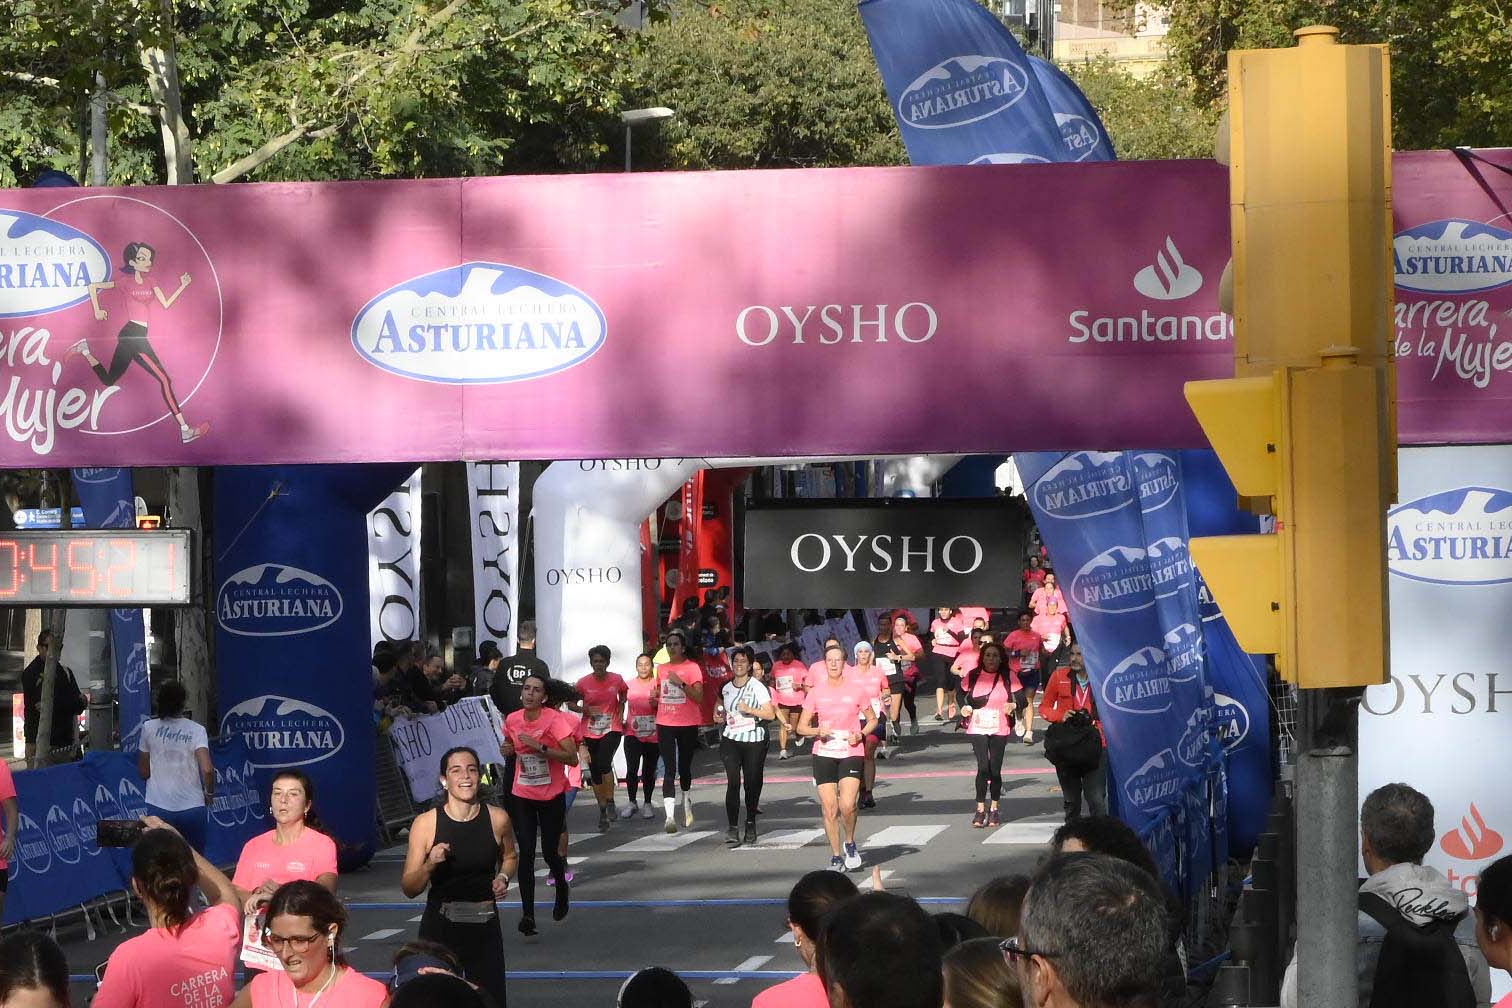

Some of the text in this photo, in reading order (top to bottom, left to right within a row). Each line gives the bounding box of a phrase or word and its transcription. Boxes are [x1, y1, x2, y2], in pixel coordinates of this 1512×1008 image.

[14, 245, 87, 257] LECHERA
[410, 302, 578, 318] CENTRAL LECHERA
[1395, 300, 1489, 329] arrera
[371, 308, 587, 354] ASTURIANA
[735, 302, 939, 346] OYSHO
[1068, 310, 1235, 343] Santand
[1417, 329, 1435, 357] la
[1431, 324, 1512, 388] Muje
[579, 459, 662, 471] OYSHO
[1416, 521, 1482, 532] CENTRAL
[790, 532, 984, 574] OYSHO
[546, 566, 622, 586] OYSHO
[221, 593, 333, 621] ASTURIANA
[513, 670, 526, 678] BP
[242, 731, 335, 751] TURIANA
[171, 966, 228, 998] CARRERA
[184, 984, 220, 1005] DE LA
